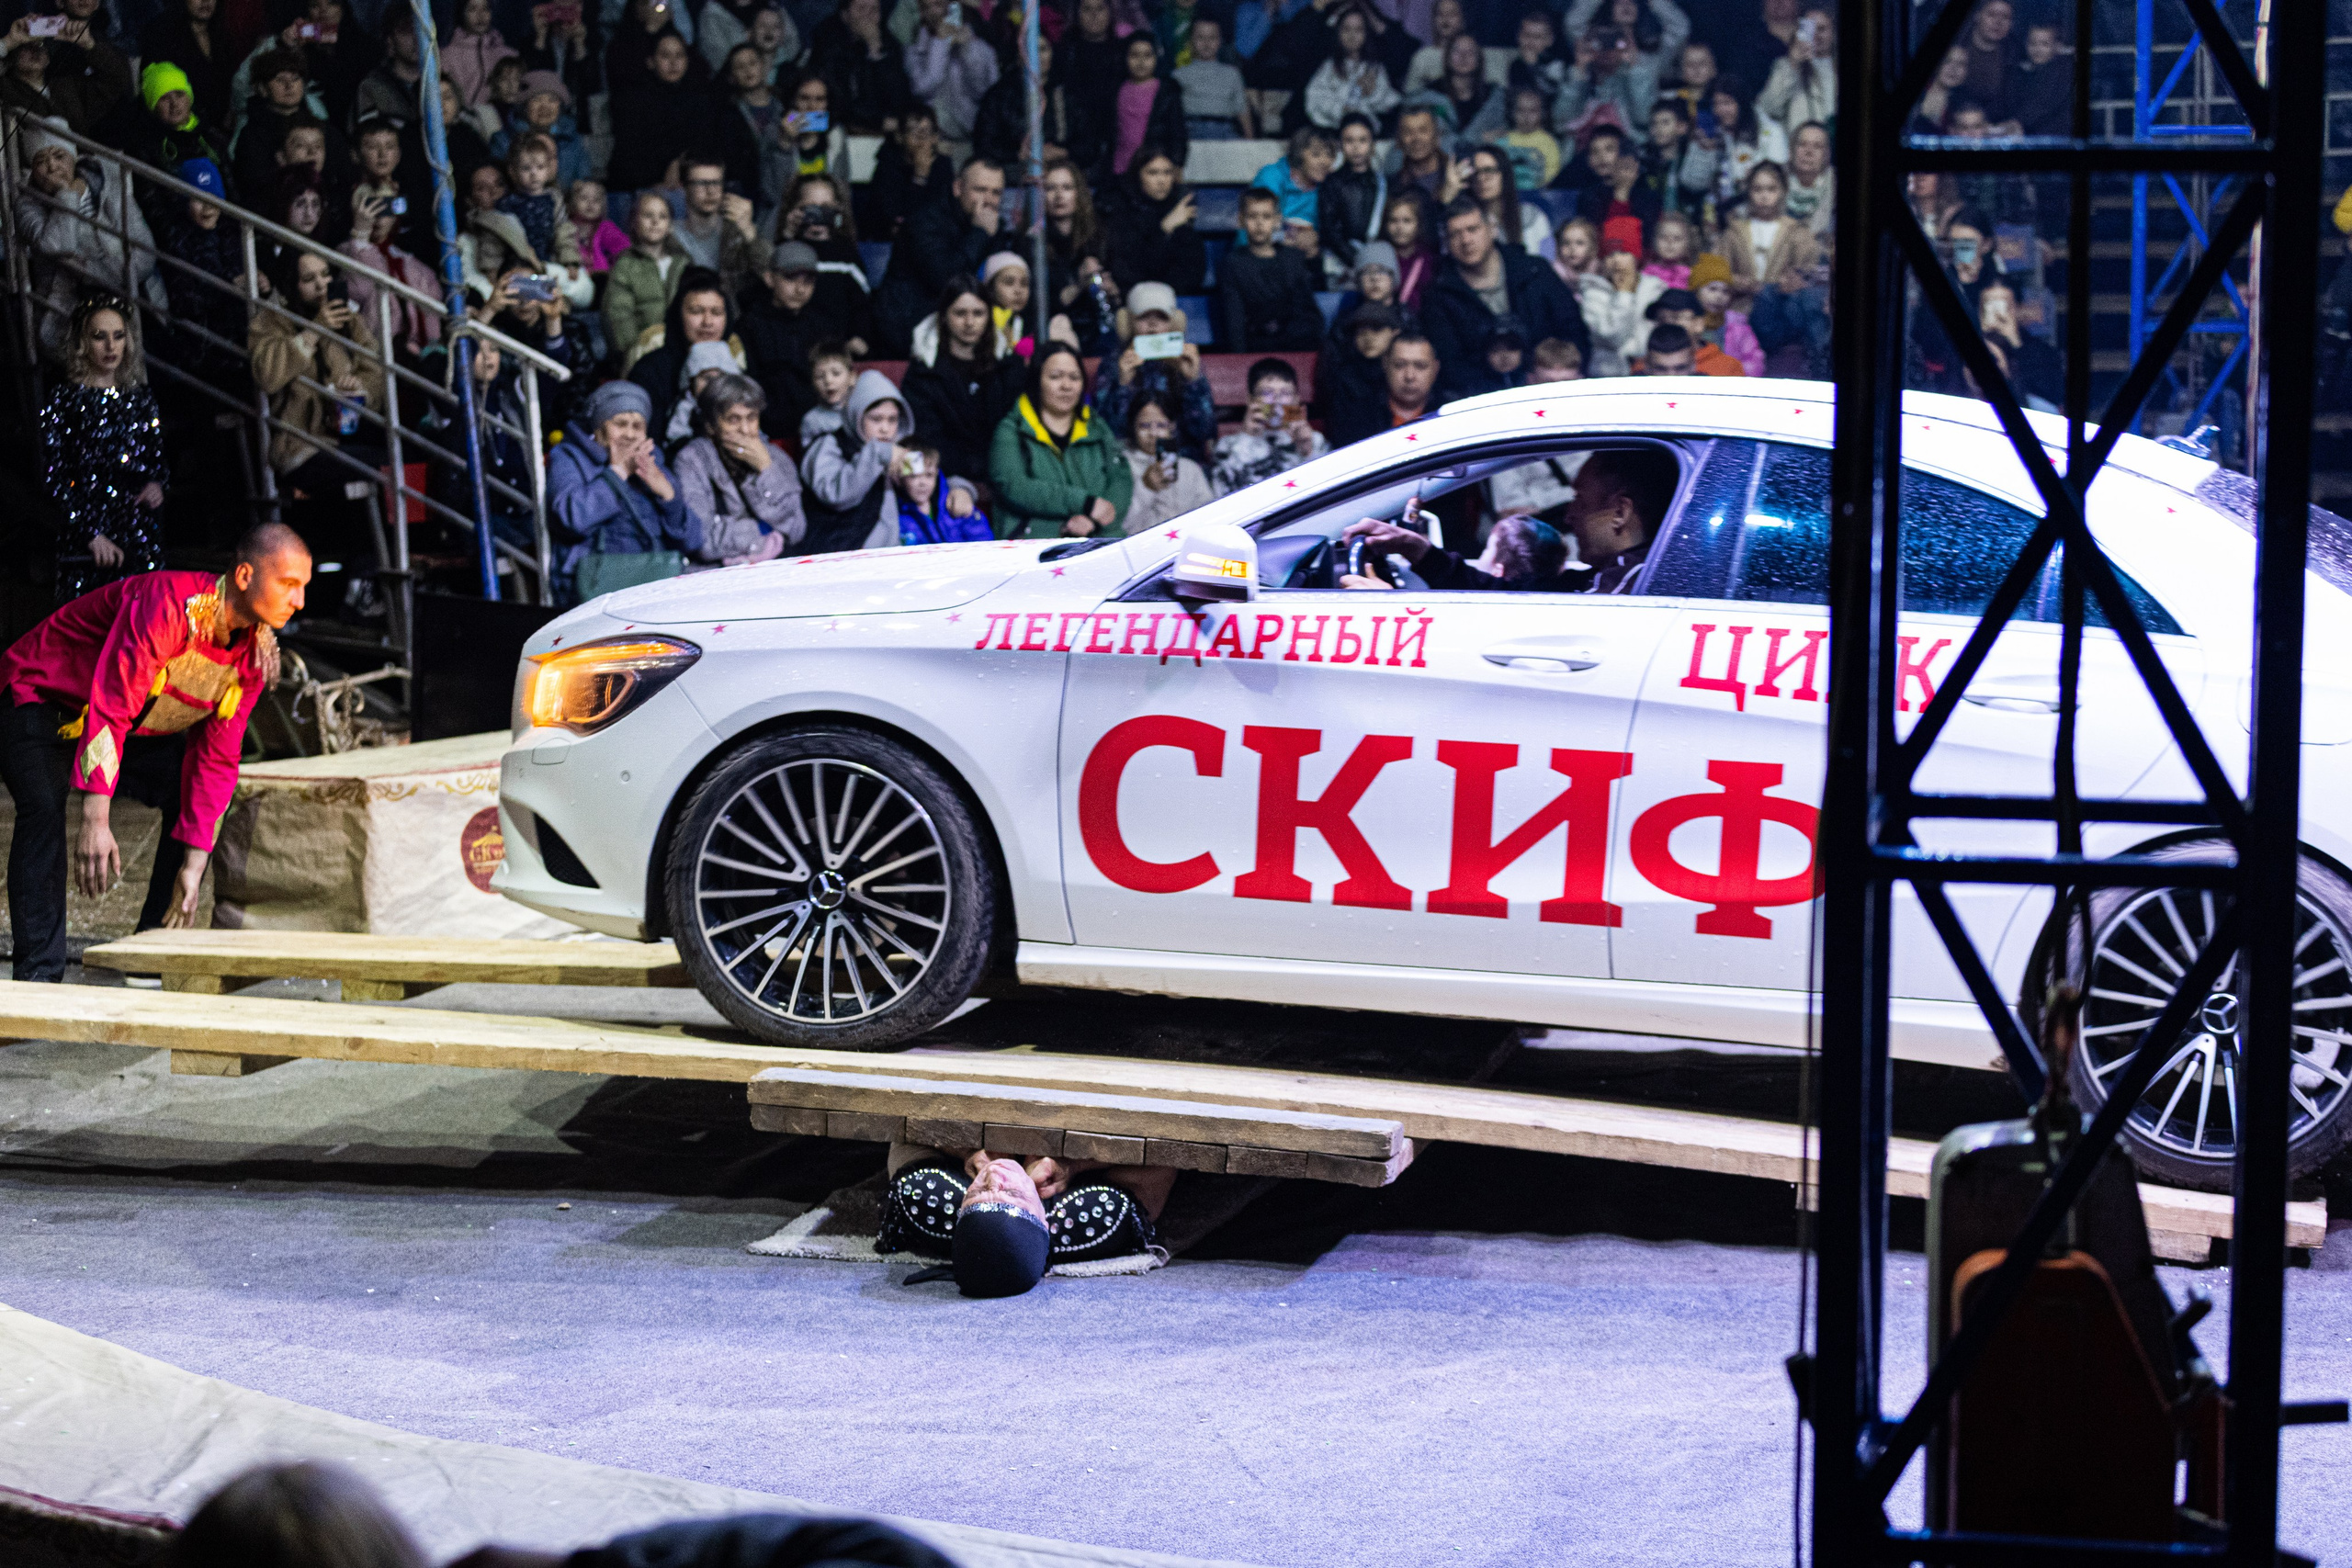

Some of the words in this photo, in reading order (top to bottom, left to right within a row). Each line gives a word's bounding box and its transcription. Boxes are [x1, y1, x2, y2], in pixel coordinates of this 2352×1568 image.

[975, 606, 1434, 668] ЛЕГЕНДАРНЫЙ
[1679, 623, 1951, 714] ЦИК
[1078, 714, 1826, 940] СКИФ
